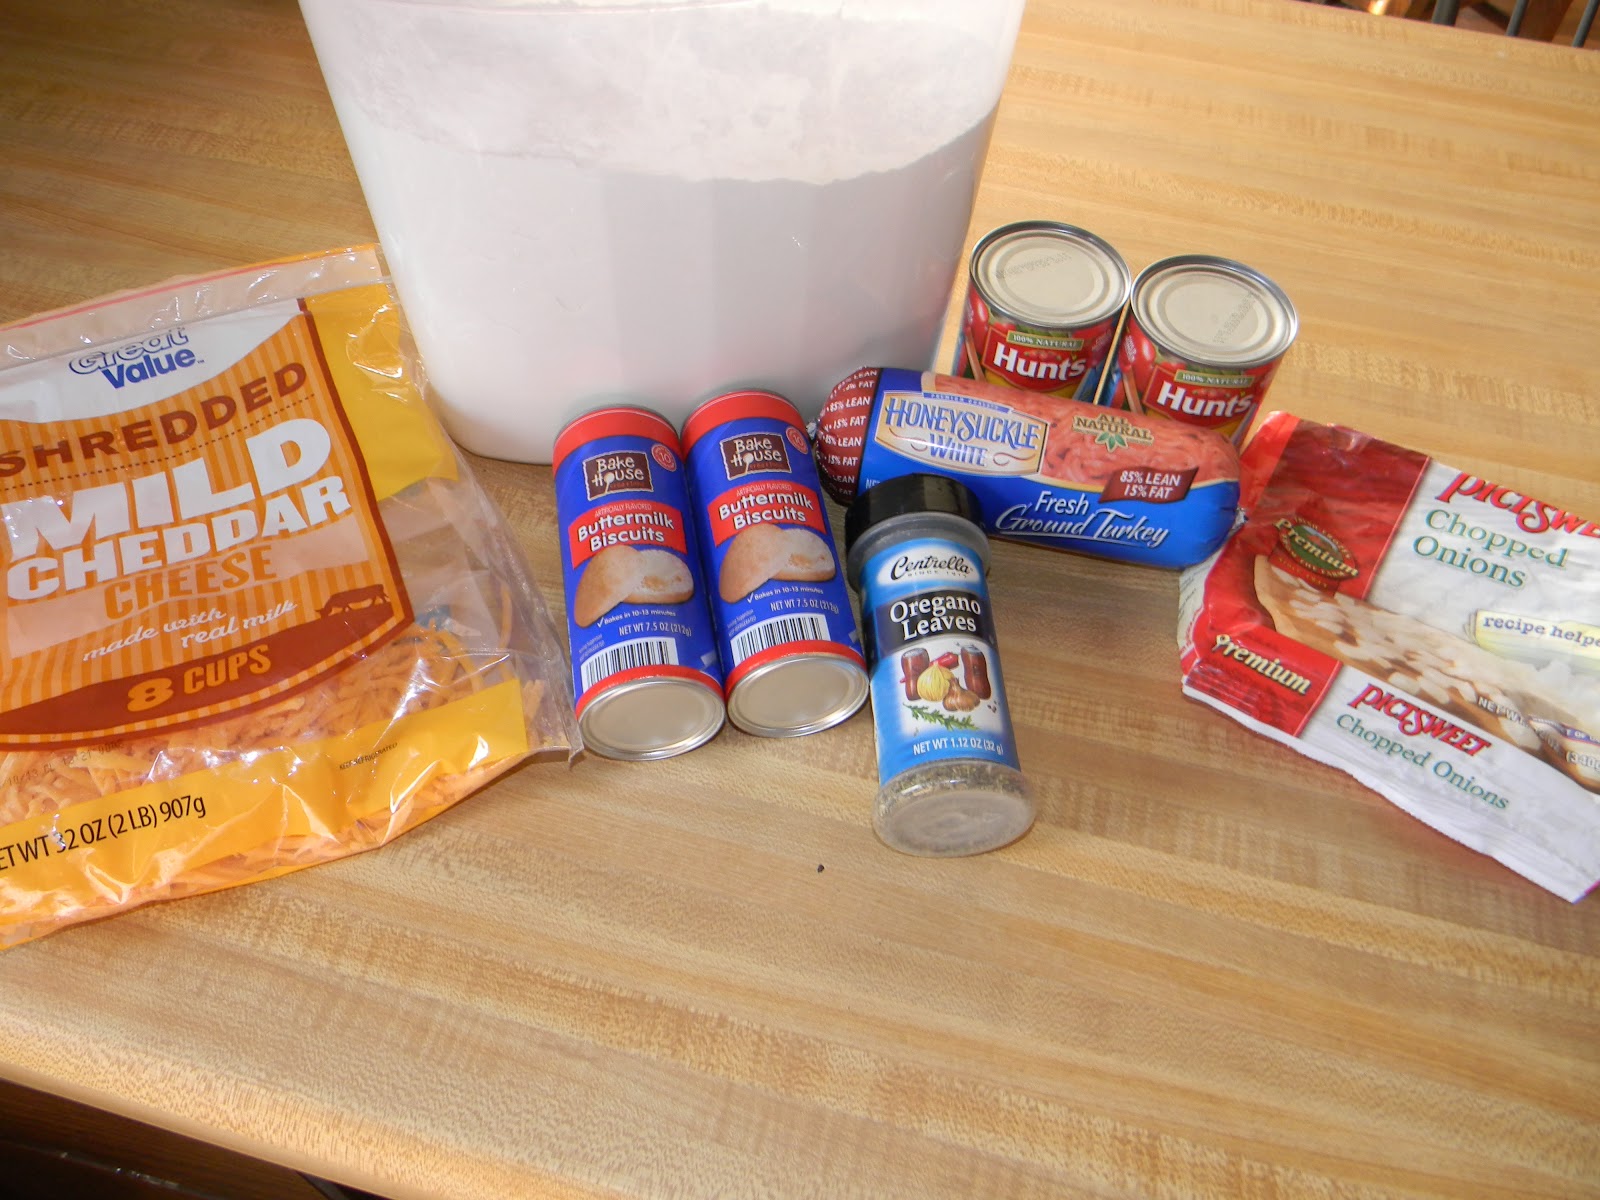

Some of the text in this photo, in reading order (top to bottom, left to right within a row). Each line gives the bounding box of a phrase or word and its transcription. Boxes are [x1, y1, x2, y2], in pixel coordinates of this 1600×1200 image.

[69, 327, 189, 375] Great
[1013, 334, 1034, 344] 100%
[101, 348, 196, 389] Value
[1182, 373, 1204, 383] 100%
[845, 396, 871, 408] LEAN
[0, 362, 307, 478] SHREDDED
[833, 416, 866, 430] 15% FAT
[1075, 417, 1154, 441] NATURAL
[1098, 414, 1128, 425] ALL
[734, 437, 773, 454] Bake
[837, 437, 862, 448] LEAN
[596, 456, 635, 475] Bake
[842, 456, 858, 467] FAT
[1, 417, 332, 563] MILD
[1120, 470, 1181, 487] 85% LEAN
[1034, 491, 1090, 517] Fresh
[1124, 484, 1173, 500] 15% FAT
[718, 491, 814, 521] Buttermilk
[733, 505, 807, 531] Biscuits
[7, 475, 352, 600] CHEDDAR
[577, 511, 675, 542] Buttermilk
[995, 503, 1171, 548] Ground Turkey
[590, 526, 665, 553] Biscuits
[1273, 517, 1358, 577] Premium
[1425, 509, 1569, 569] Chopped
[890, 555, 971, 581] Centrella
[1412, 535, 1527, 588] Onions
[104, 545, 278, 621] CHEESE
[800, 586, 824, 595] minutes
[604, 613, 623, 625] Bakes
[632, 609, 650, 617] 10-13
[651, 609, 677, 617] minutes
[770, 601, 783, 613] NET
[784, 599, 796, 609] WT
[810, 599, 819, 609] OZ
[890, 595, 981, 623] Oregano
[82, 607, 227, 662] made with
[181, 599, 298, 649] real milk
[619, 621, 692, 637] NET WT 7.5 OZ (212g)
[901, 615, 977, 641] Leaves
[1483, 616, 1546, 636] recipe
[1212, 633, 1312, 695] Premium
[127, 644, 272, 713] 8 CUPS
[913, 740, 932, 756] NET
[932, 738, 949, 750] WT
[950, 737, 969, 749] 1.12
[970, 737, 982, 749] OZ
[1336, 713, 1510, 811] Chopped Onions
[16, 834, 50, 864] WT
[79, 818, 108, 846] OZ
[107, 812, 129, 840] (2
[127, 803, 158, 830] LB)
[159, 794, 207, 823] 907g
